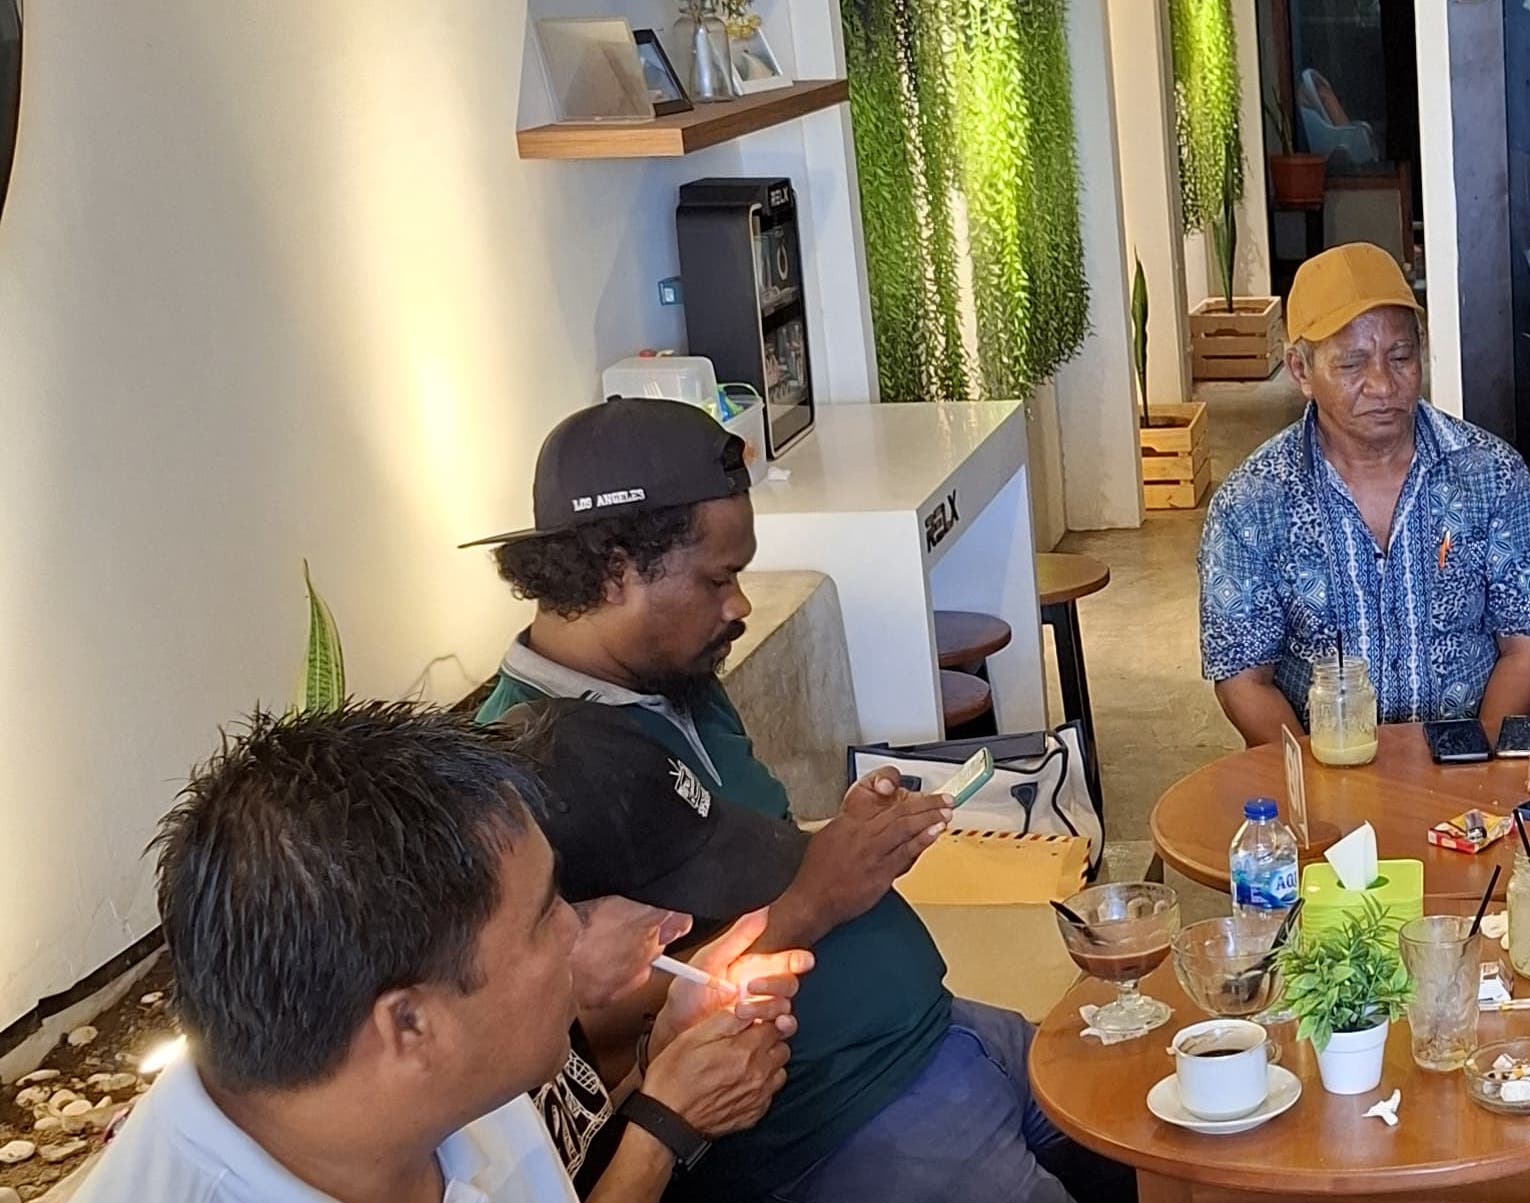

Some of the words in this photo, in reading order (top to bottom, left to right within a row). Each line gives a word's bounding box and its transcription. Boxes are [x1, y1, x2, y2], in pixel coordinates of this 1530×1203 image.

[572, 497, 593, 512] LOS
[596, 488, 646, 507] ANGELES
[924, 489, 959, 553] RELX
